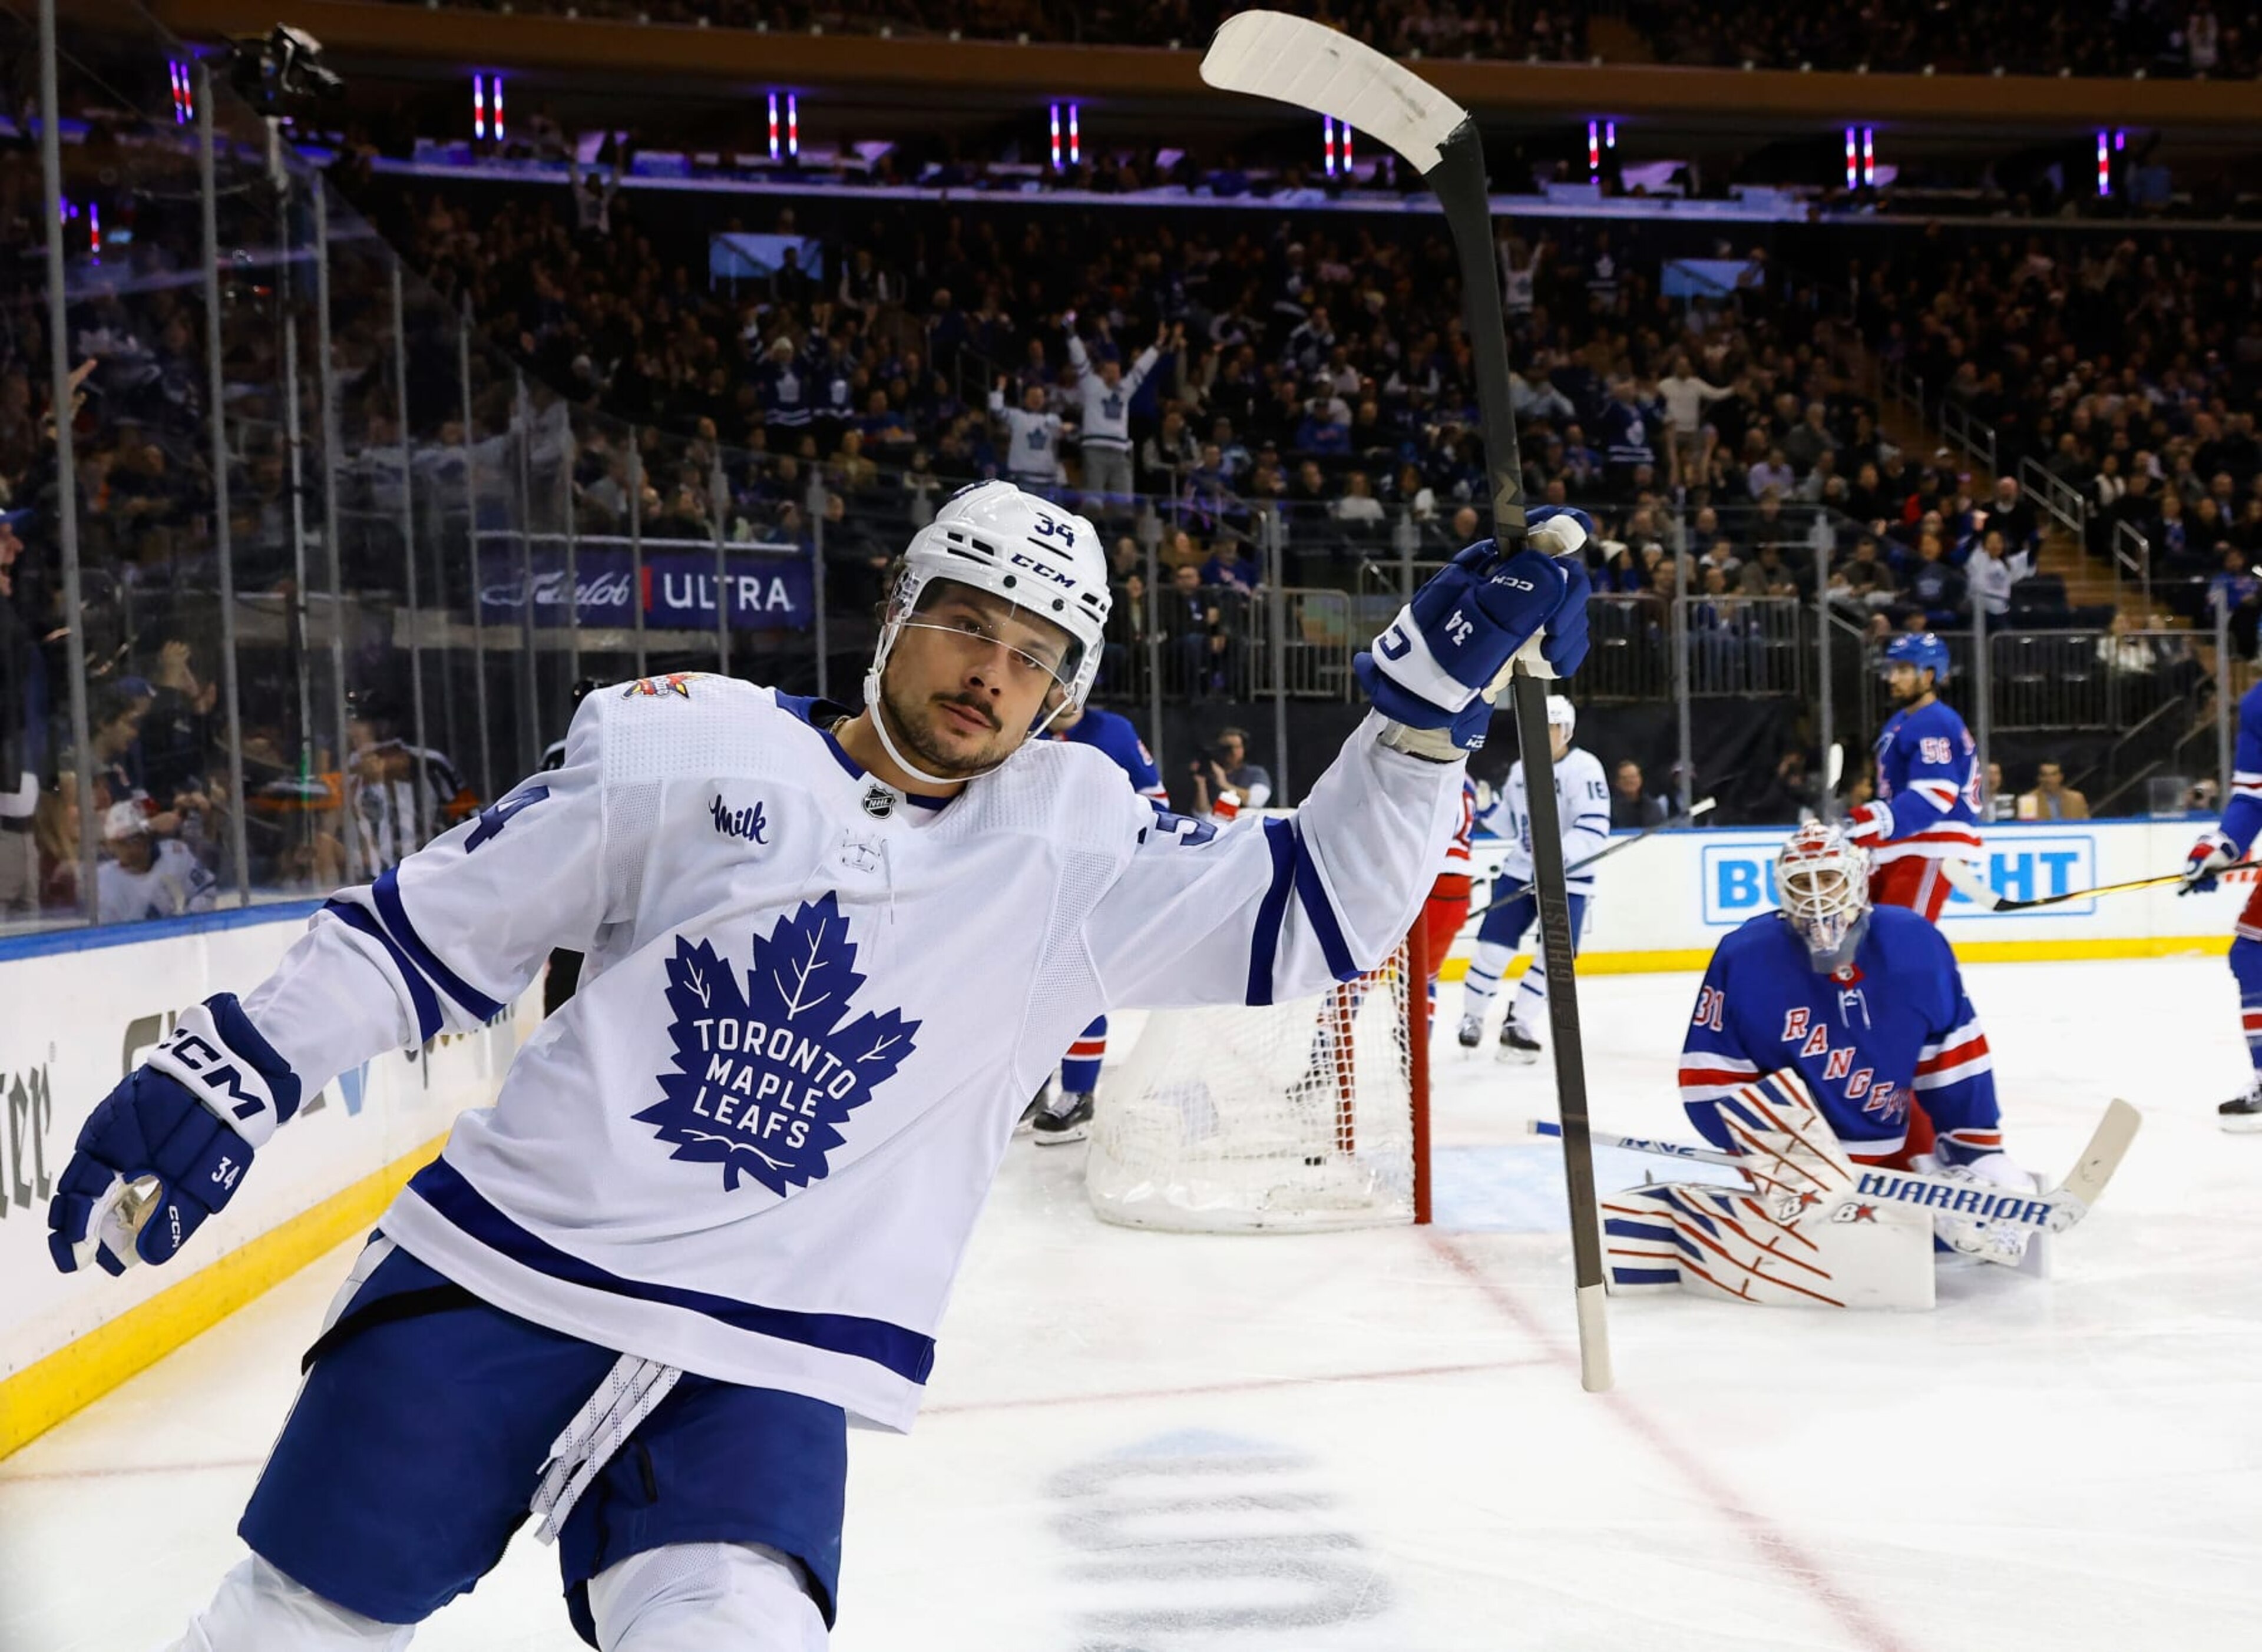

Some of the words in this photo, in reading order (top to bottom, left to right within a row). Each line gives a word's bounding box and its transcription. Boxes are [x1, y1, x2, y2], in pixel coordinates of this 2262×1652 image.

[1034, 511, 1075, 548] 34
[1010, 552, 1077, 589] CCM
[1491, 574, 1535, 592] CCM
[1444, 609, 1473, 647] 34
[868, 797, 891, 809] NHL
[1692, 985, 1726, 1032] 31
[693, 1018, 857, 1100] TORONTO
[705, 1052, 824, 1118] MAPLE
[692, 1085, 810, 1148] LEAFS
[211, 1156, 240, 1191] 34
[1857, 1173, 2053, 1226] WARRIOR
[168, 1206, 182, 1249] CCM
